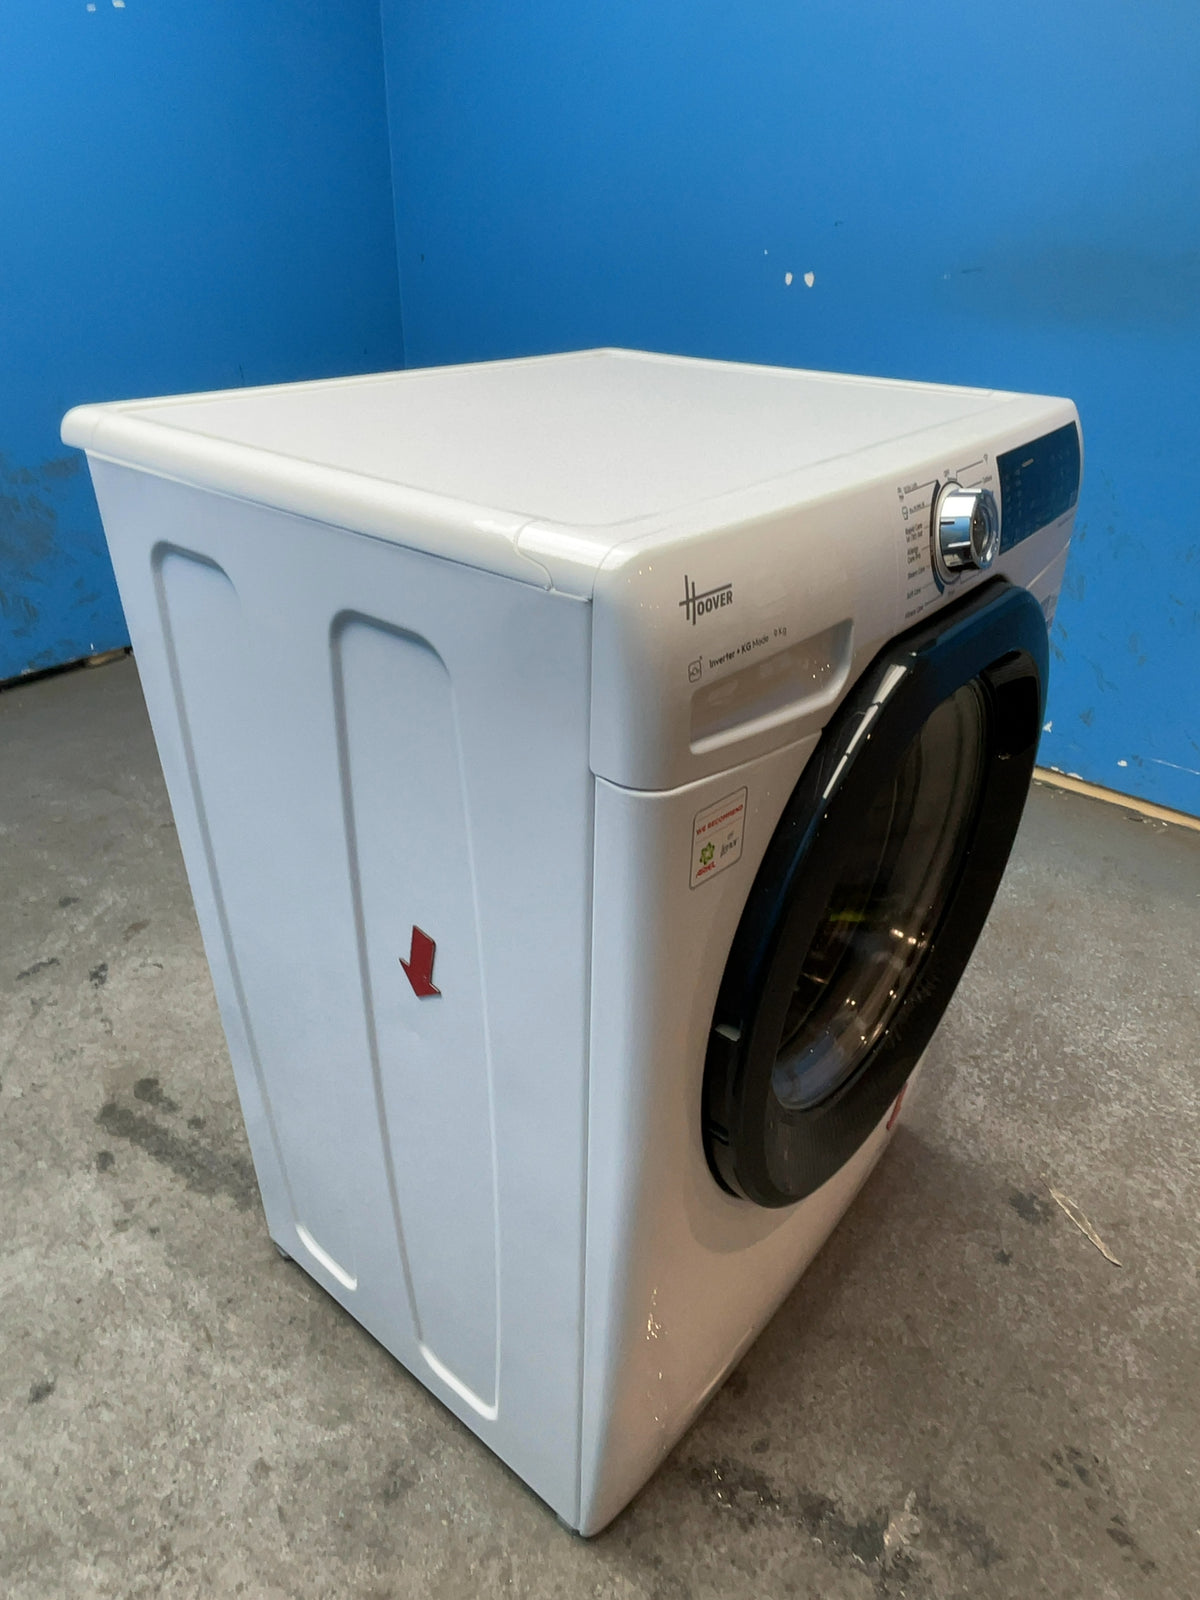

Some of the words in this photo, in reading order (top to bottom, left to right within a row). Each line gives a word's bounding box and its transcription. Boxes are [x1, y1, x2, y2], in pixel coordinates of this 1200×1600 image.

[679, 575, 733, 626] HOOVER
[709, 650, 736, 668] Inverter
[741, 641, 752, 655] KG
[707, 804, 743, 828] RECOMMEND
